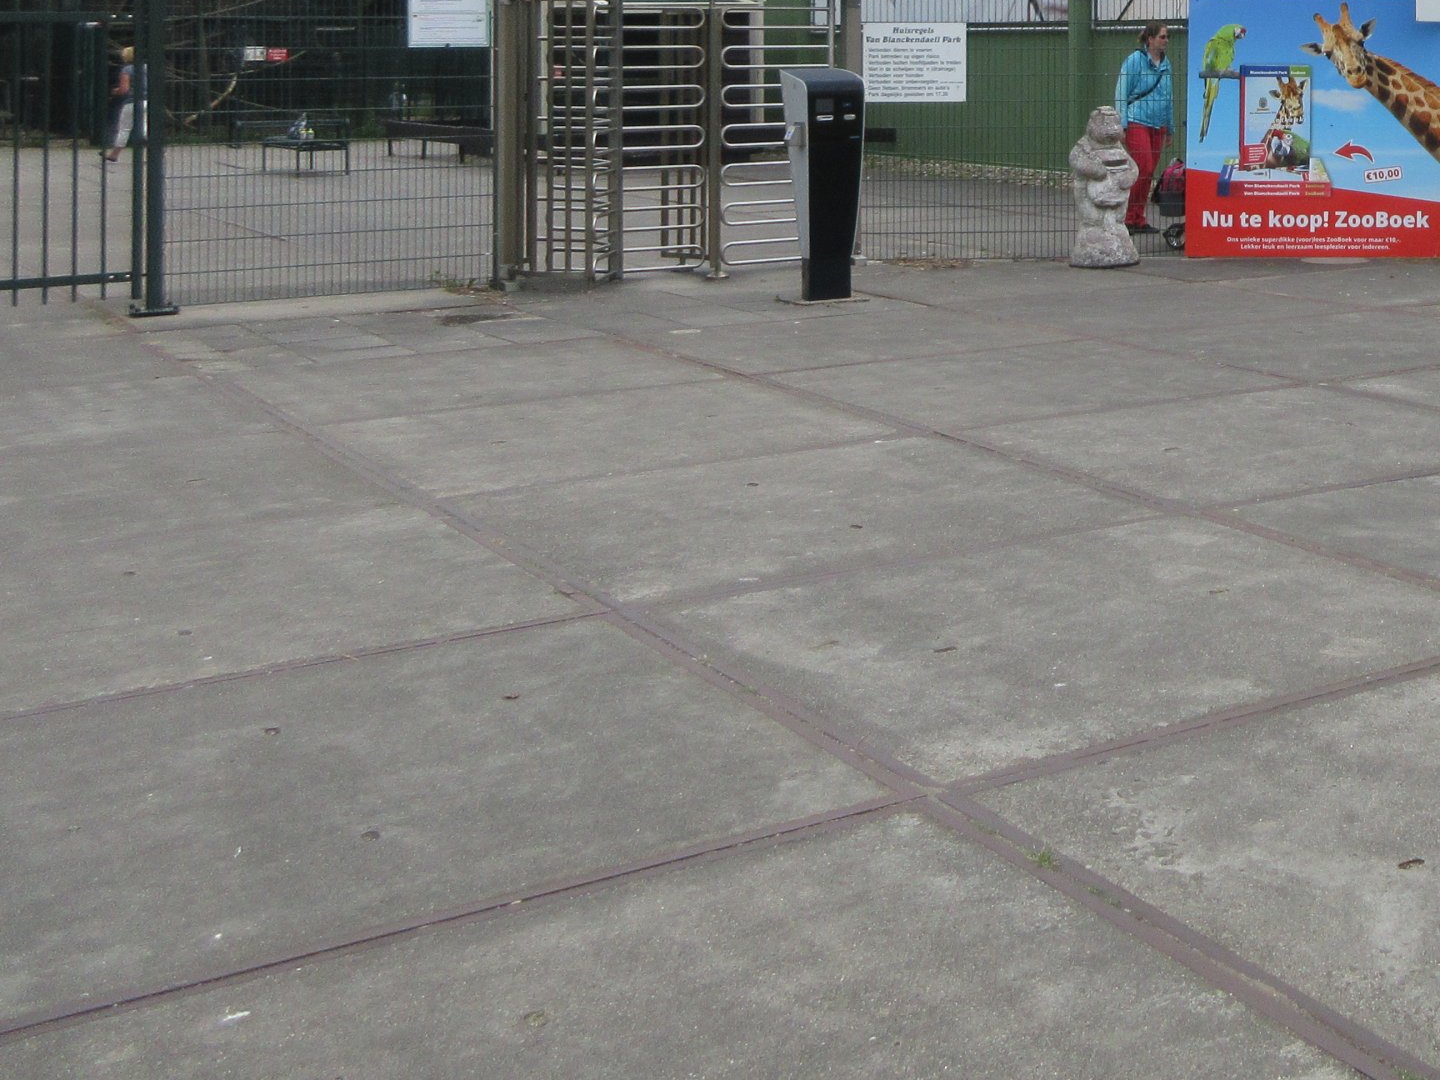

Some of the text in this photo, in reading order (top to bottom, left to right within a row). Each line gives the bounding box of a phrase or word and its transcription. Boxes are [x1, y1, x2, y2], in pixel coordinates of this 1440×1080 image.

[892, 27, 935, 35] Huisregels
[1366, 169, 1400, 181] €10,00
[1202, 210, 1430, 233] Nu te koop! ZooBoek
[1261, 236, 1295, 244] superdikke
[1314, 243, 1346, 251] leesplezier
